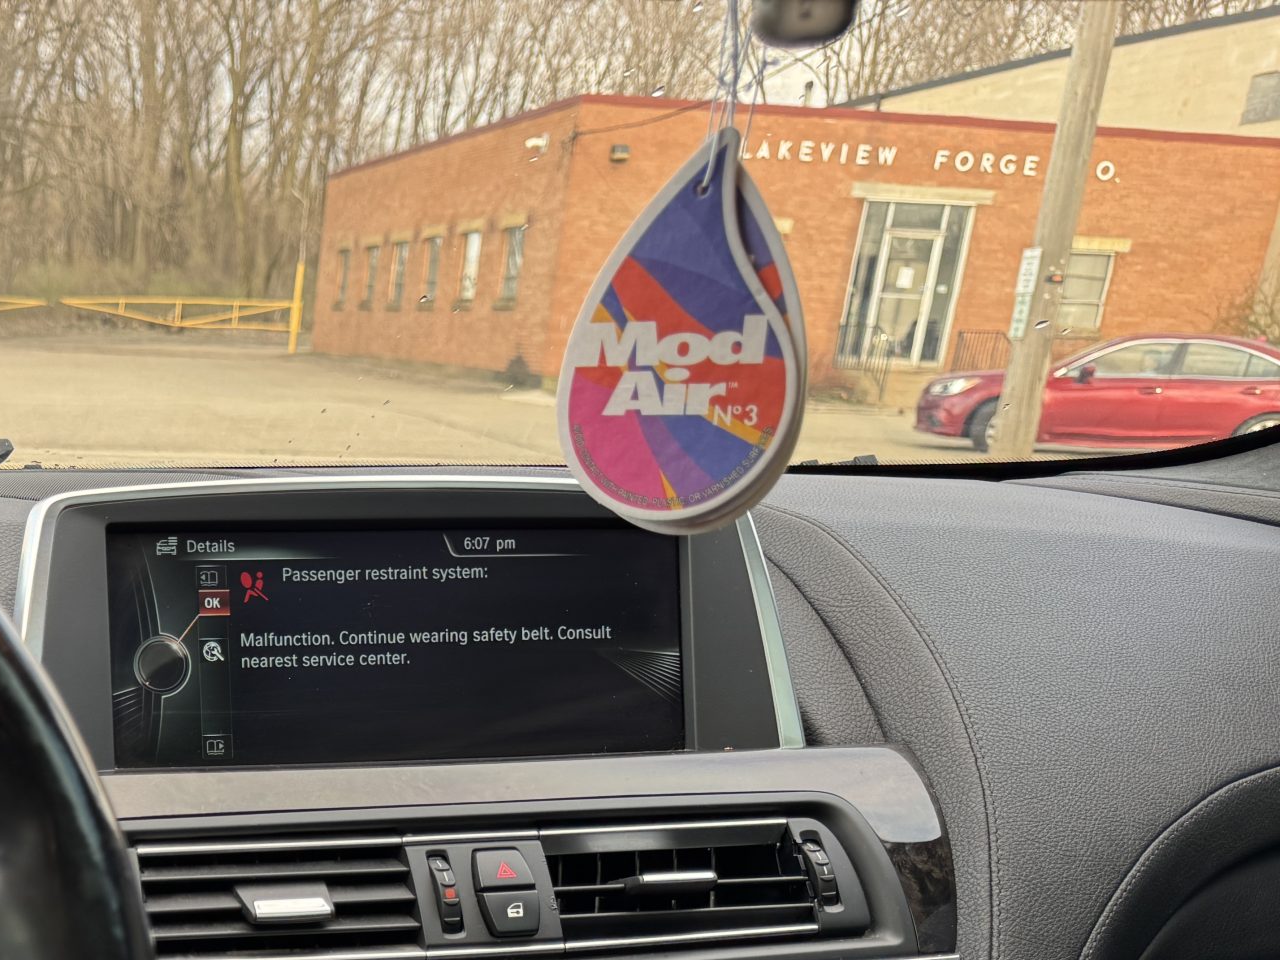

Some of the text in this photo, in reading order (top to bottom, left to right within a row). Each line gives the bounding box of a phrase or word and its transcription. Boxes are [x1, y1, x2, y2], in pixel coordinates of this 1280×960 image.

[739, 138, 1121, 183] LAKEVIEW FORGE O.
[576, 314, 769, 367] Mod
[601, 367, 726, 416] Air
[186, 540, 235, 553] Details
[463, 537, 516, 552] 6:07 pm
[282, 566, 489, 584] Passenger restraint system:
[204, 597, 221, 609] OK
[240, 626, 611, 647] Malfunction. Continue wearing safety belt. Consult
[241, 652, 410, 669] nearest service center.
